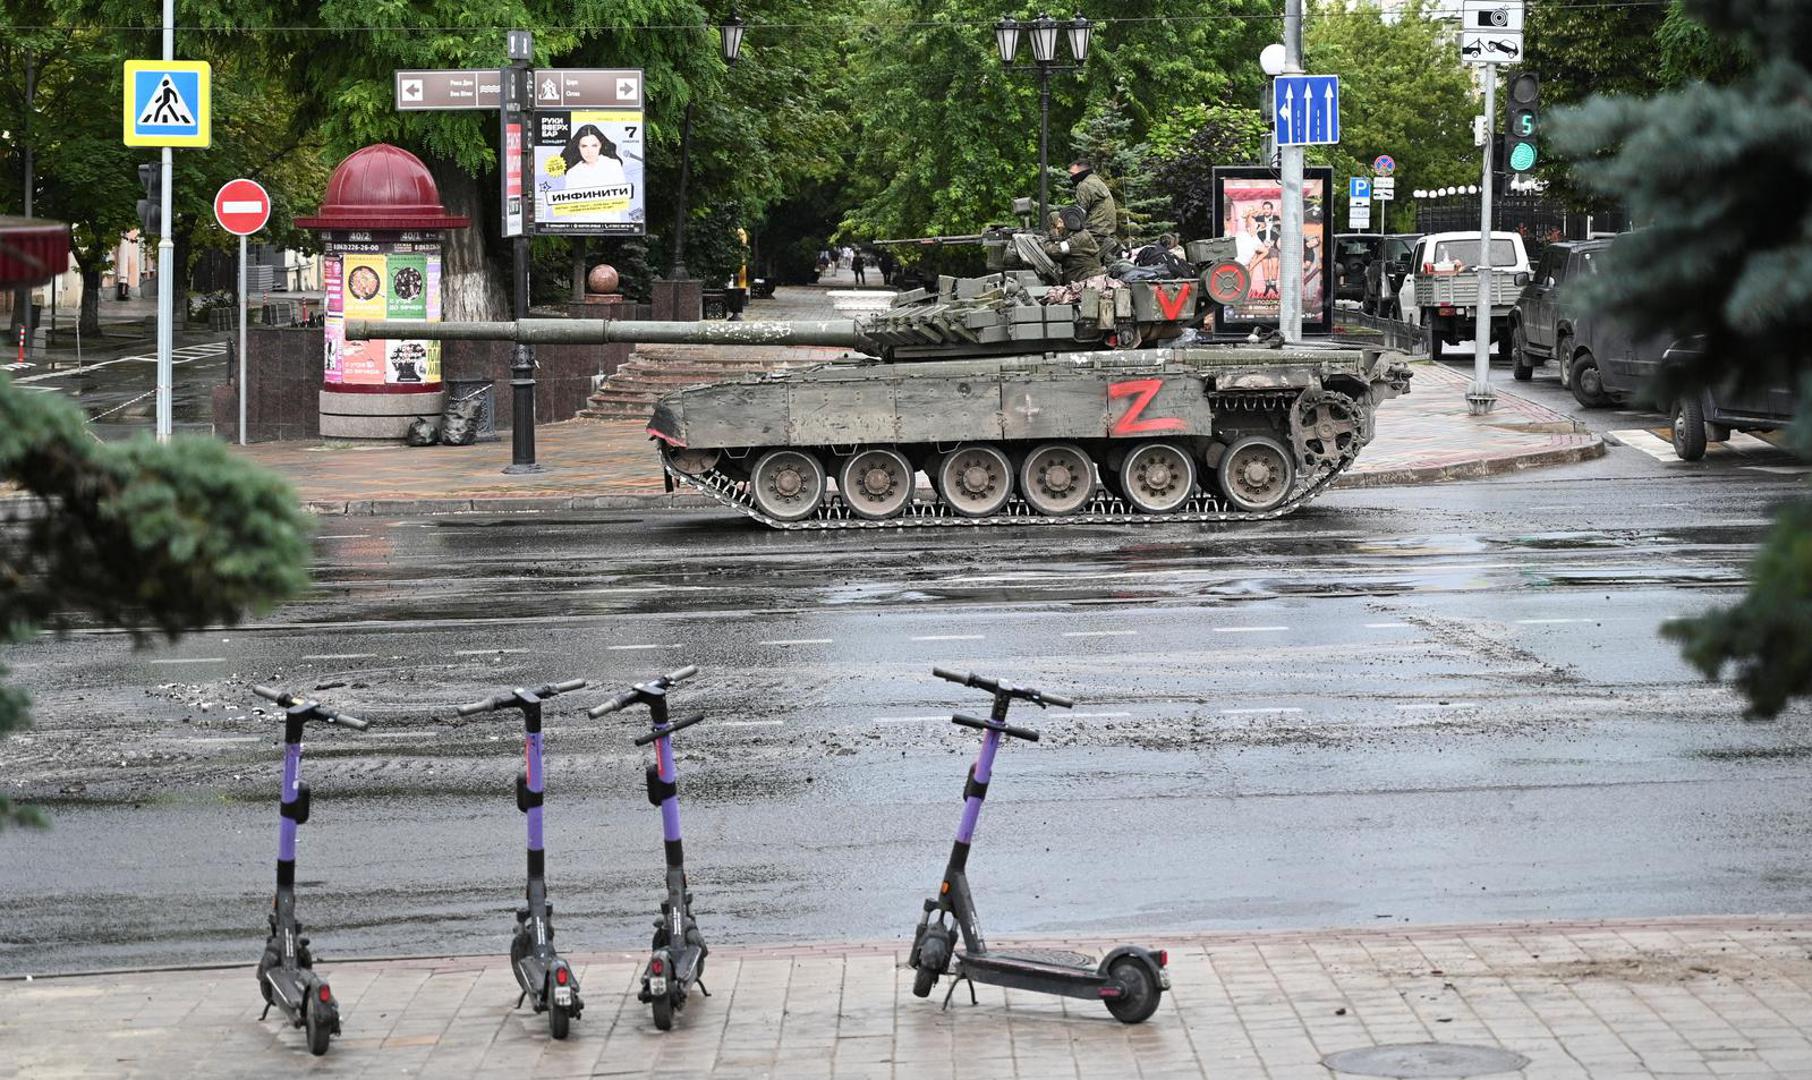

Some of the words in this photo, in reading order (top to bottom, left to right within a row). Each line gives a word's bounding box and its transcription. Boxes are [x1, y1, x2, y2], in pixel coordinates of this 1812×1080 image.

[625, 126, 637, 138] 7
[1522, 115, 1532, 134] 5
[552, 187, 628, 202] ИНФИНИТИ
[1356, 180, 1367, 196] P
[1155, 283, 1191, 320] V
[1108, 378, 1190, 435] Z
